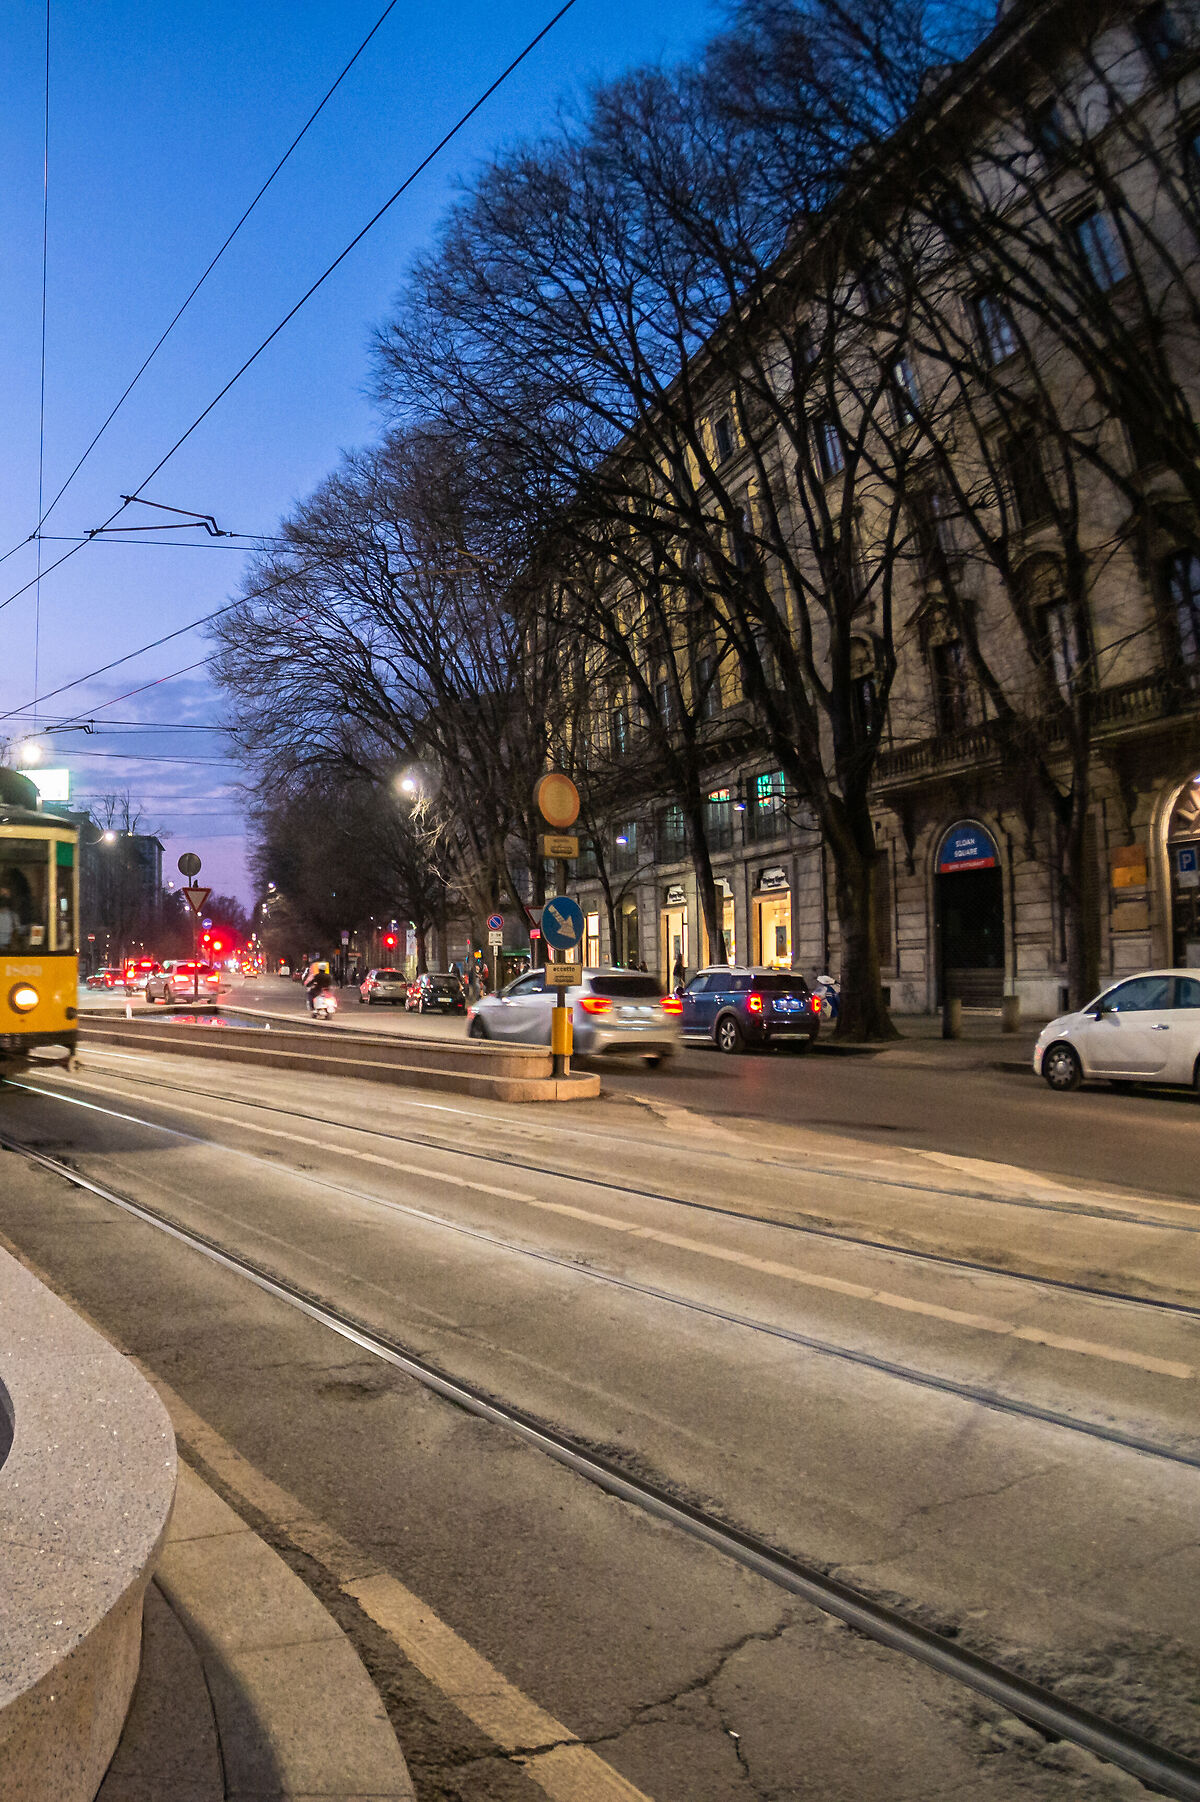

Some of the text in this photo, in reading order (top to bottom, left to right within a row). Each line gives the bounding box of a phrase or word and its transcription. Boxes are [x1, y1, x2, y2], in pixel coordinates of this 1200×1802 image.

[955, 838, 976, 848] SLOAN
[954, 847, 978, 858] SQUARE
[1183, 854, 1191, 869] P
